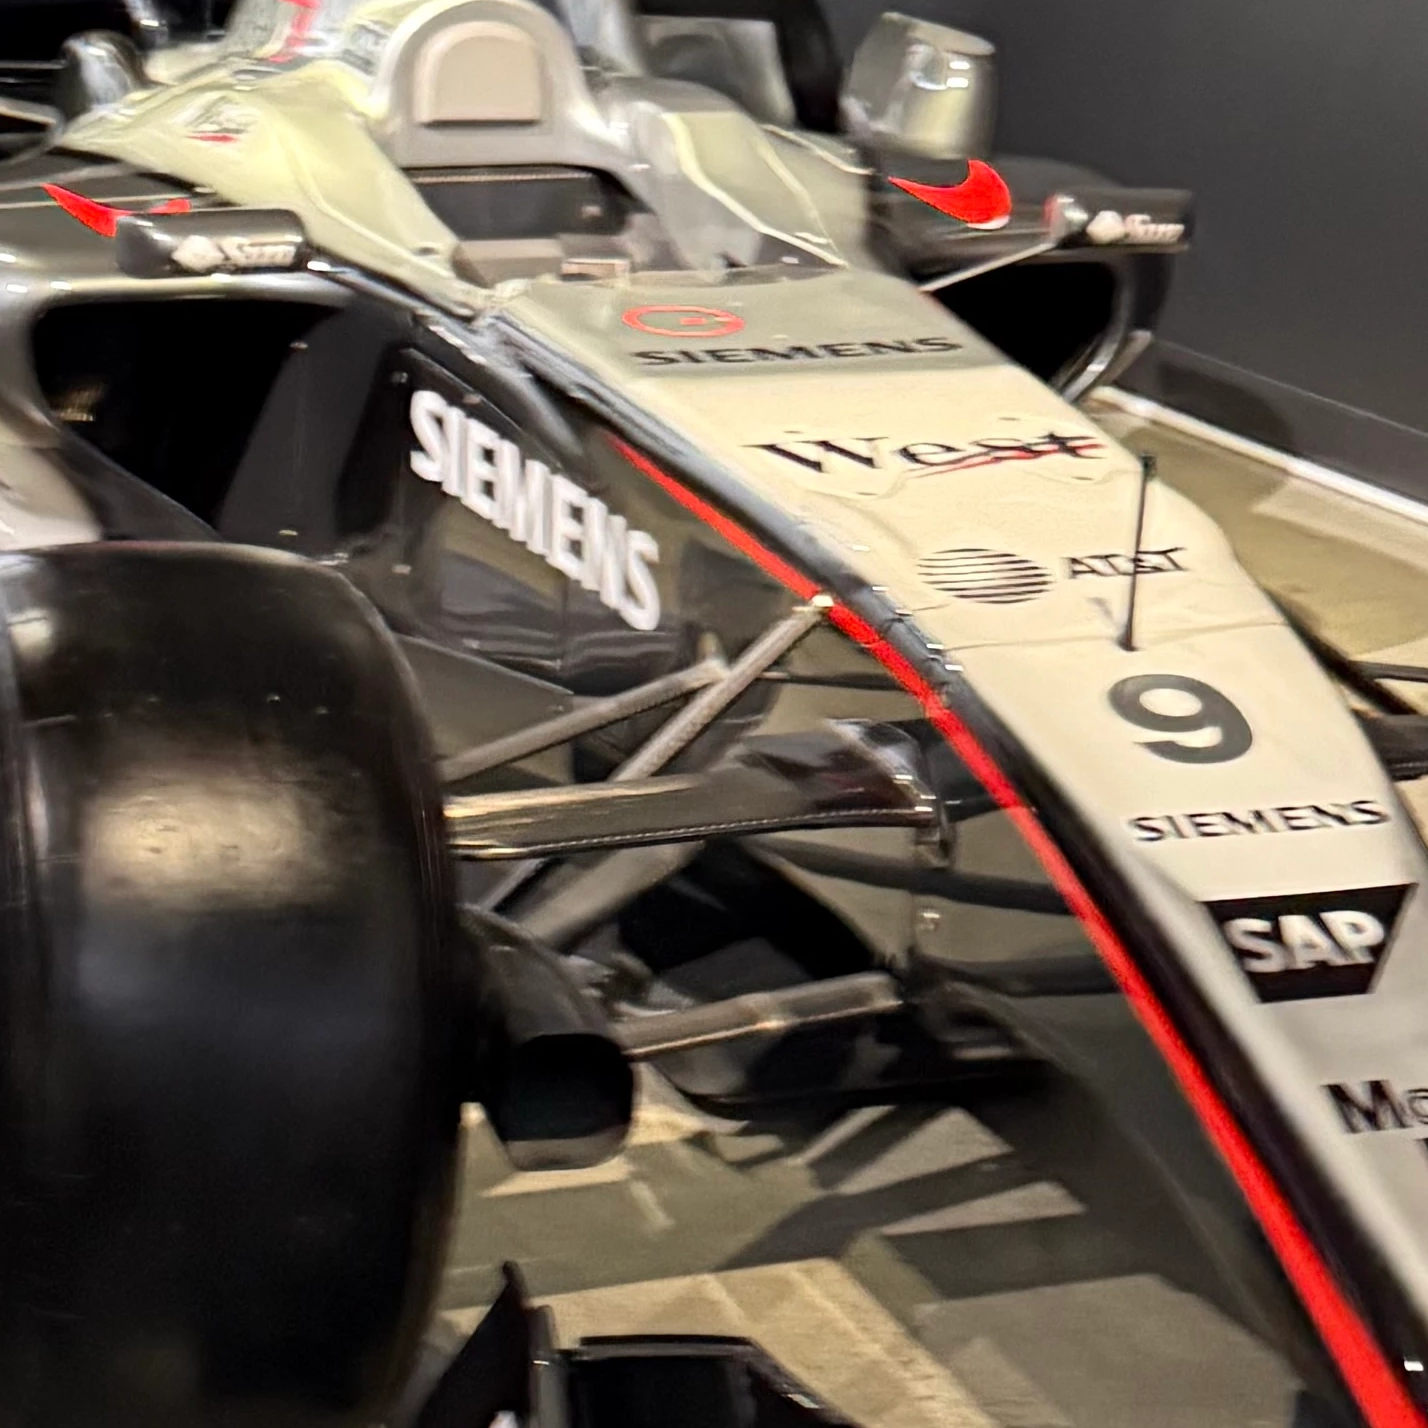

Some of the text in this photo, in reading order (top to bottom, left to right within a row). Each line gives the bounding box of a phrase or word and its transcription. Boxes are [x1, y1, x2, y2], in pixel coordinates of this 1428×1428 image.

[630, 337, 963, 365] SIEMENS
[740, 431, 1105, 476] West
[409, 389, 661, 632] SIEMENS
[1061, 546, 1189, 580] AT&T
[1106, 672, 1254, 765] 9
[1129, 800, 1391, 842] SIEMENS
[1223, 908, 1385, 973] SAP
